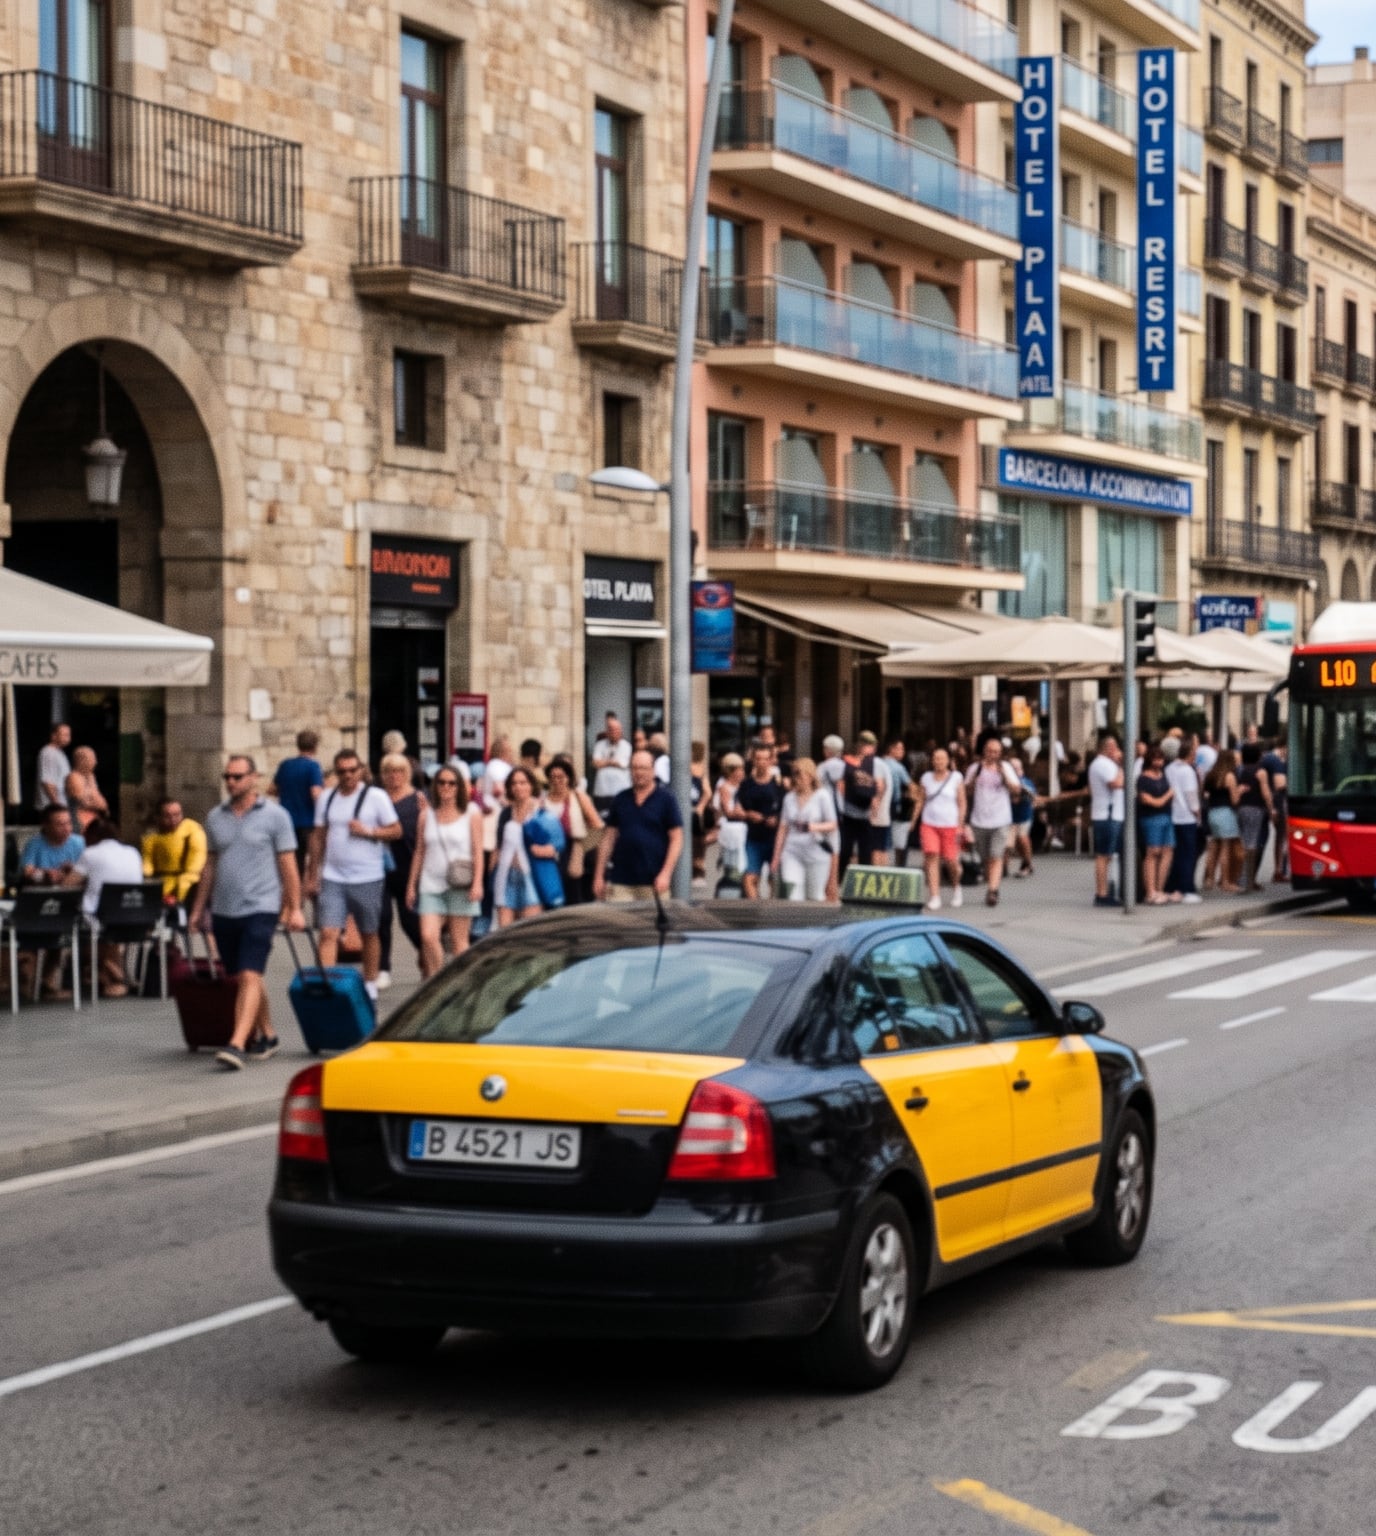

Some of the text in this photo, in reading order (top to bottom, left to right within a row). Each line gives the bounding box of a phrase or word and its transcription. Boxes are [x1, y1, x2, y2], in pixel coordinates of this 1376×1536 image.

[1022, 63, 1047, 368] HOTEL PLAA
[1143, 55, 1168, 381] HOTEL RESRT
[1005, 454, 1087, 493] BARCELONA
[614, 580, 654, 603] PLAYA
[1320, 659, 1357, 687] L10
[853, 871, 901, 898] TAXI
[427, 1126, 573, 1162] B 4521 JS
